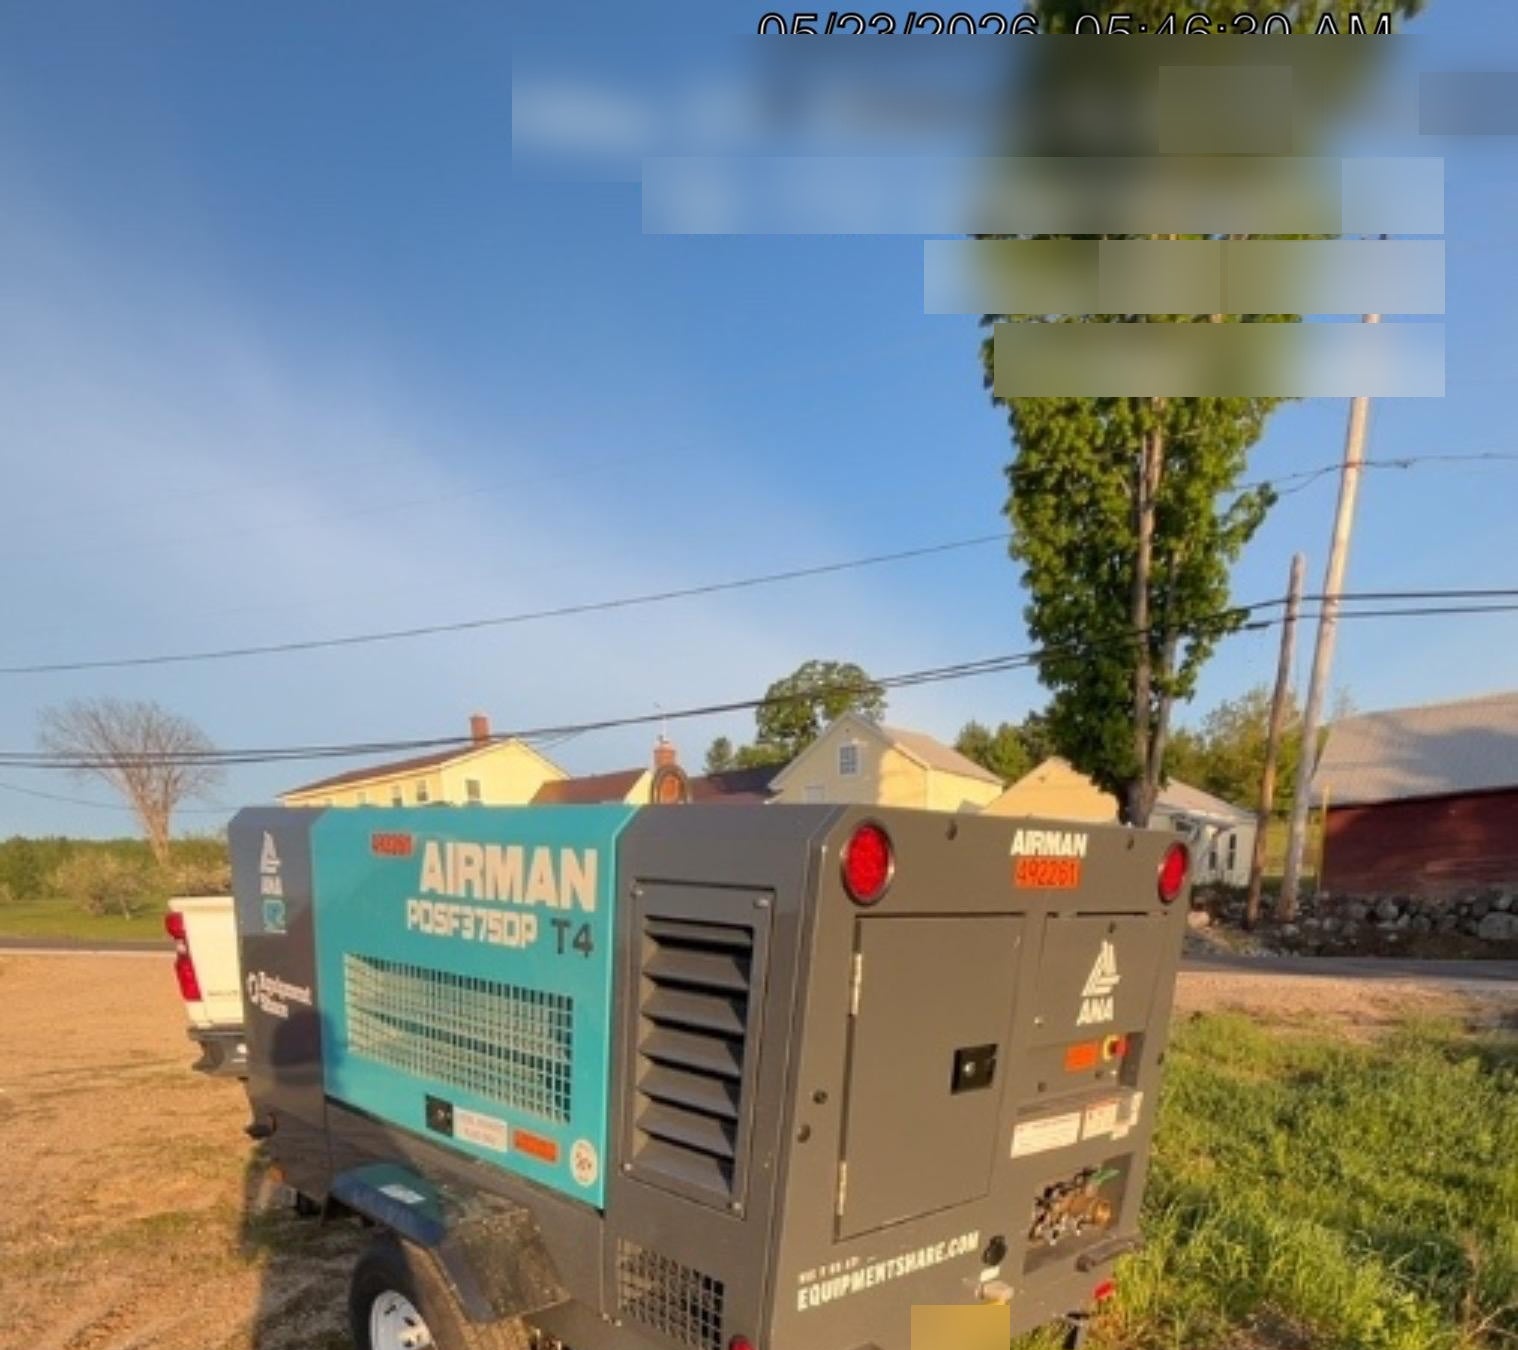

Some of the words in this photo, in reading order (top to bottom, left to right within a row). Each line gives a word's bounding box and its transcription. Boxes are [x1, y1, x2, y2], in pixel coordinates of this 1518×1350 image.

[1010, 827, 1088, 858] AIRMAN
[419, 840, 598, 913] AIRMAN
[551, 917, 594, 958] T4
[1076, 996, 1114, 1026] ANA
[797, 1230, 980, 1312] EQUIPMENTSHARE.COM
